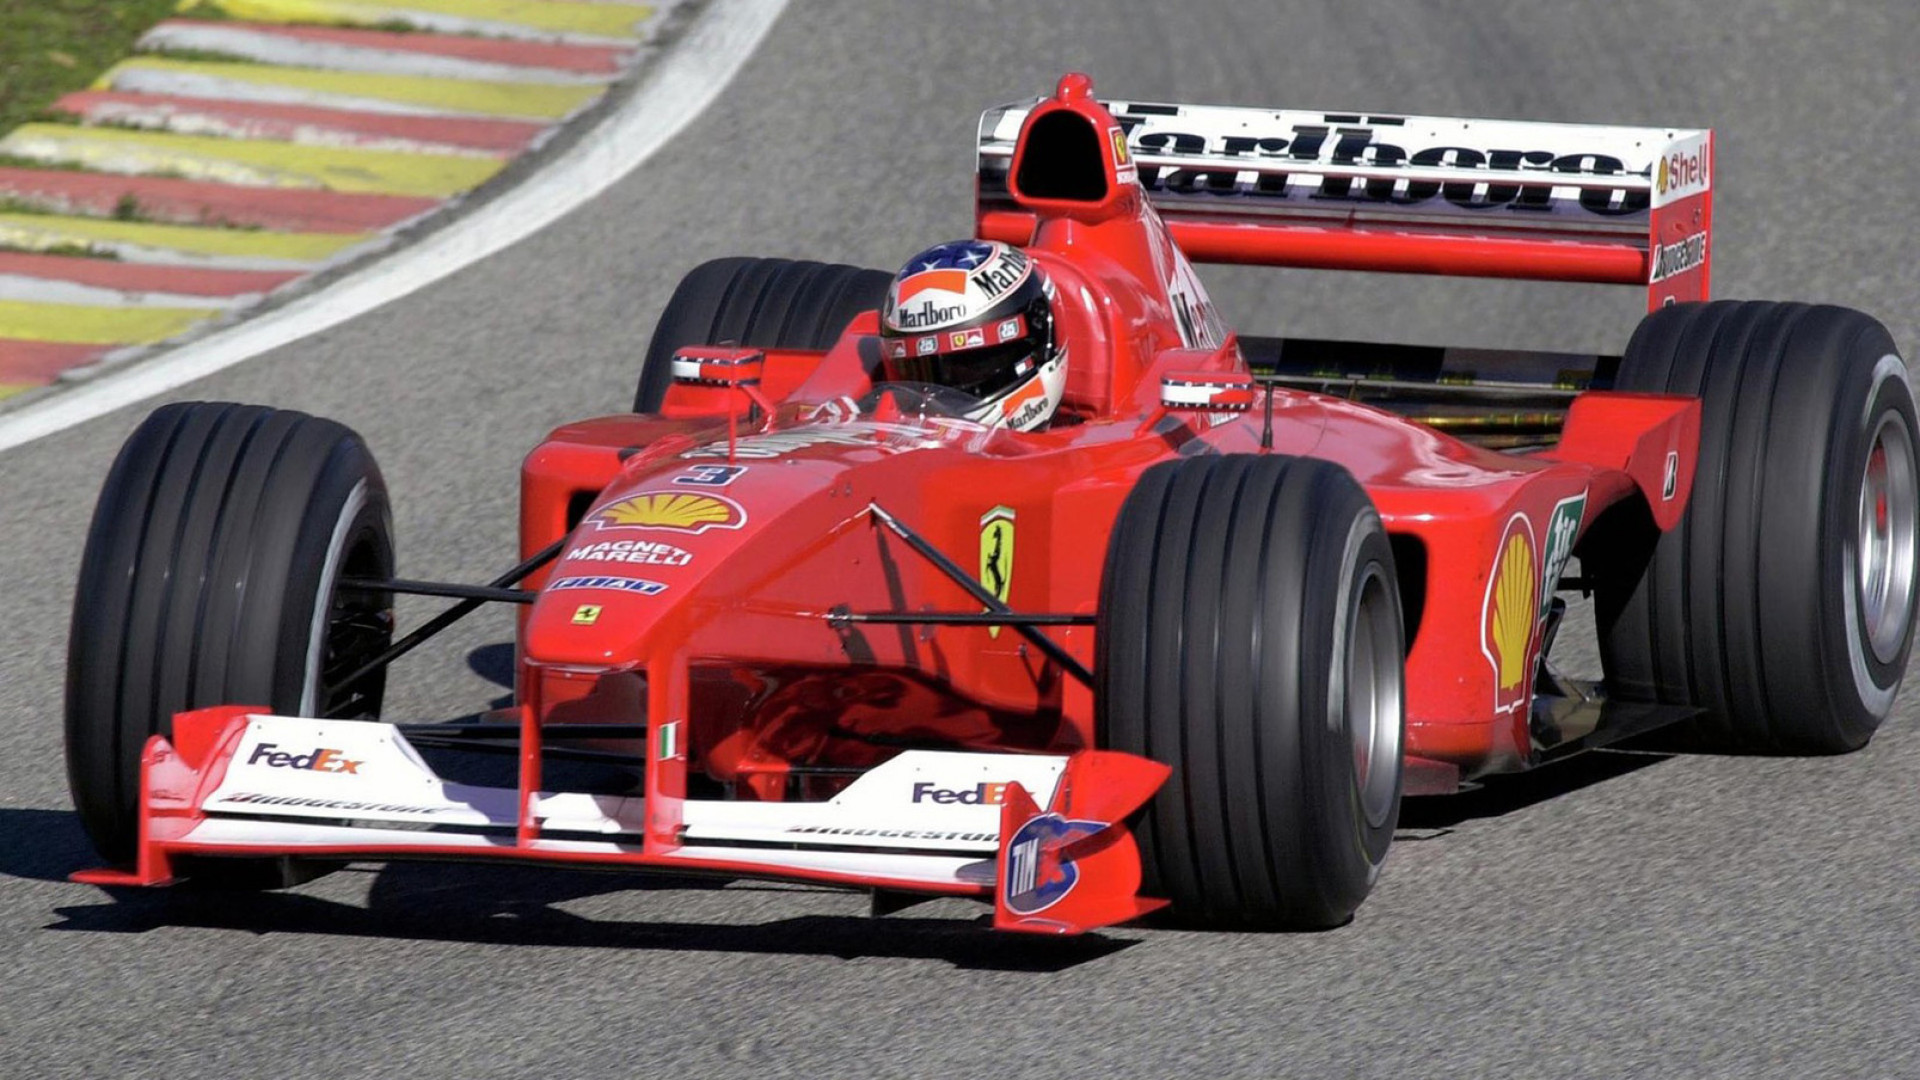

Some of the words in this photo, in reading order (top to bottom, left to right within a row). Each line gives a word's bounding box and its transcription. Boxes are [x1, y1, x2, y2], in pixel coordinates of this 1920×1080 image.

[1669, 143, 1707, 190] Shell
[900, 301, 966, 328] Marlboro
[671, 464, 750, 486] 3
[566, 545, 693, 566] MARELLI
[549, 577, 664, 595] FIAT
[247, 742, 366, 775] FedEx
[912, 782, 1007, 805] FedE
[1011, 838, 1039, 897] TIM
